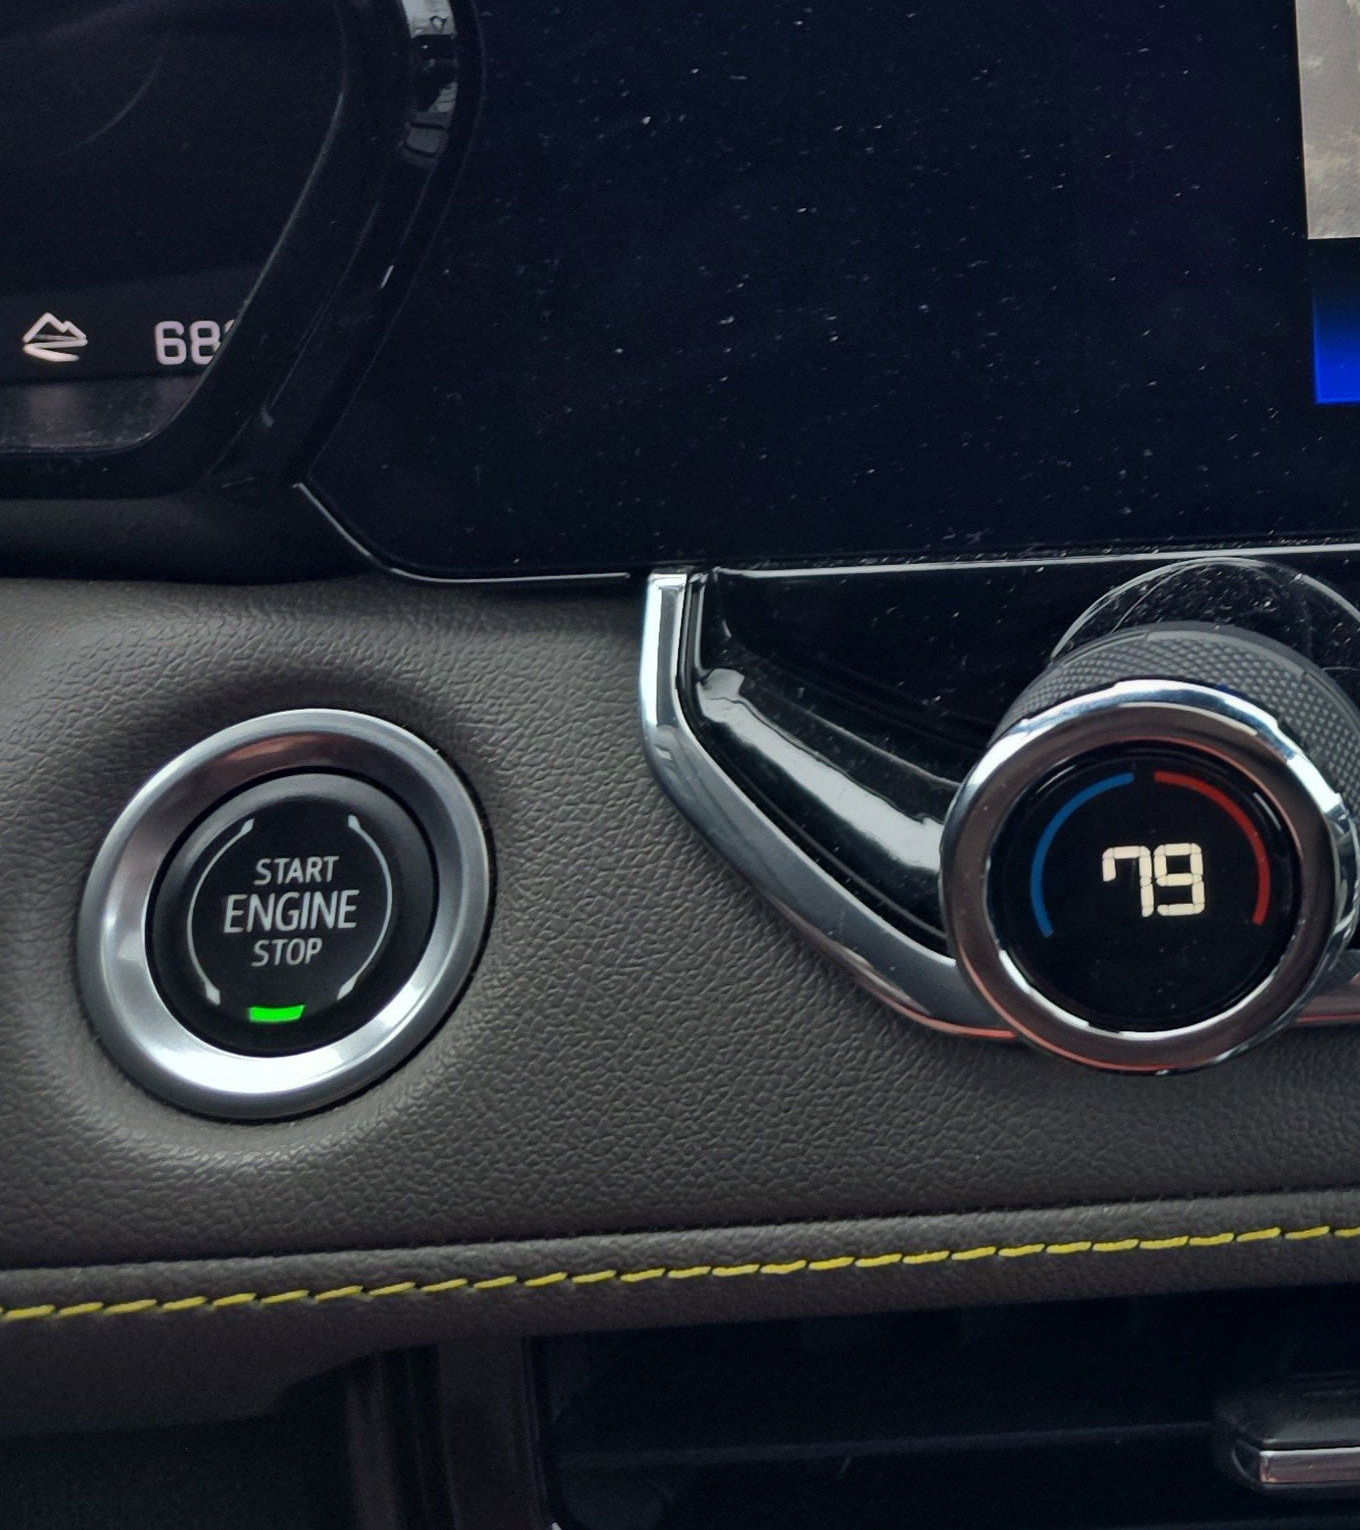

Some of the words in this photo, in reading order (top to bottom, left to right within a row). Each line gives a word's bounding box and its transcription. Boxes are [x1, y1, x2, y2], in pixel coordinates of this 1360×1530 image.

[254, 855, 340, 887] START
[1101, 842, 1206, 918] 79
[222, 889, 361, 934] ENGINE
[250, 936, 324, 968] STOP
